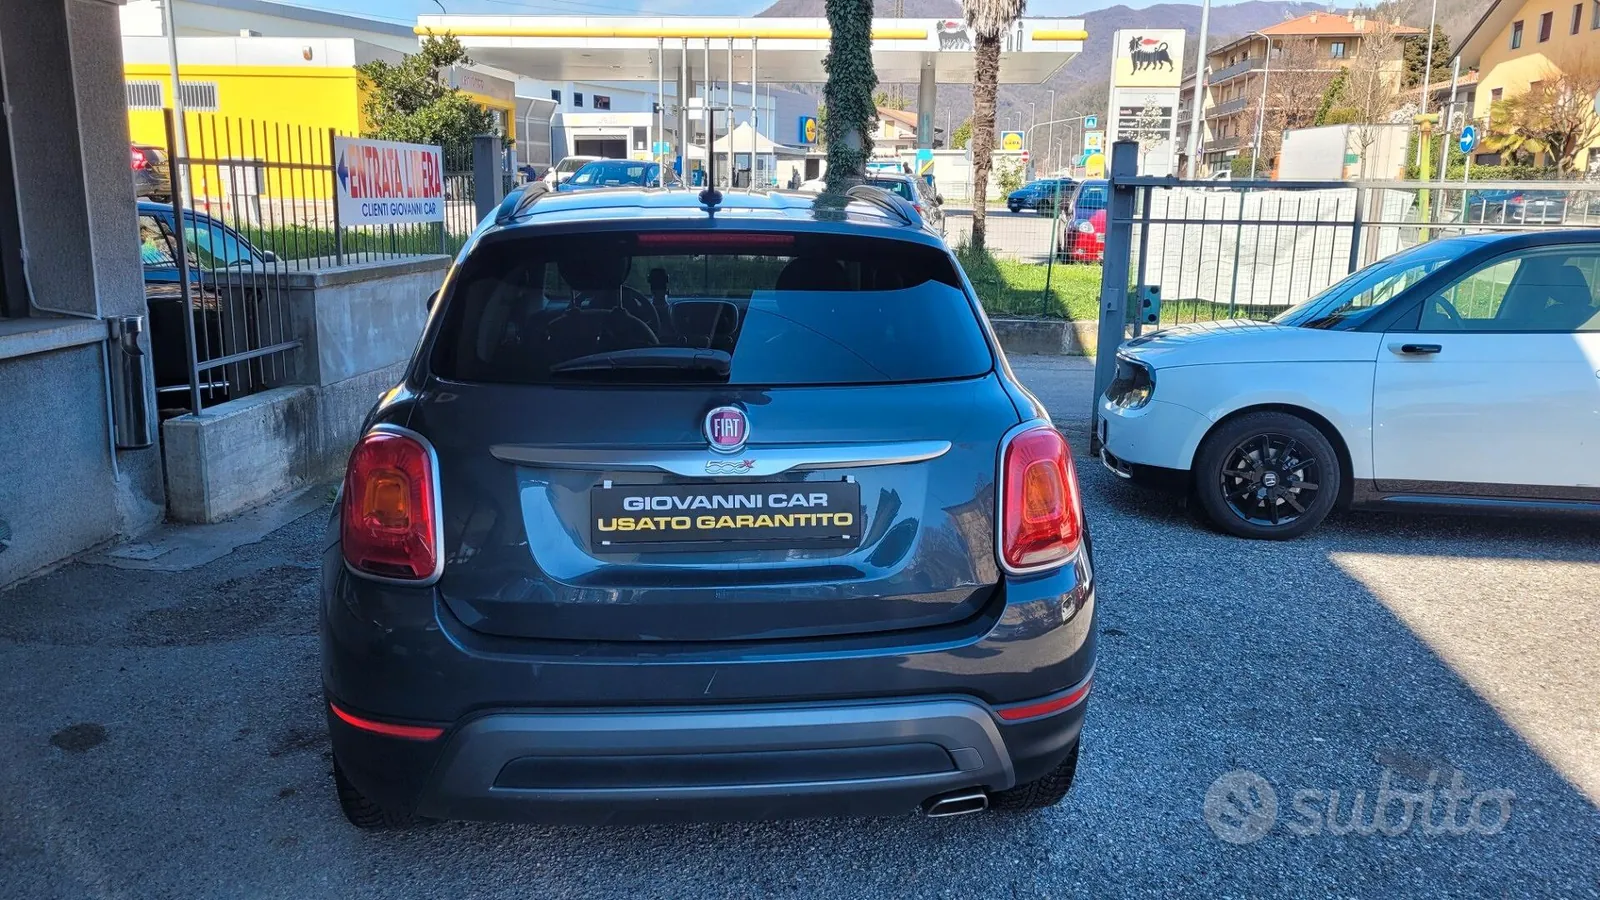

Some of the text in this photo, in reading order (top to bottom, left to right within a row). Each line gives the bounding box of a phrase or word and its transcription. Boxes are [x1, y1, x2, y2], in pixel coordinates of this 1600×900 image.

[347, 144, 404, 198] ENTRATA
[361, 202, 437, 217] CLIENTI GIOVANNI CAR
[714, 418, 740, 437] FIAT
[623, 492, 828, 511] GIOVANNI CAR
[598, 512, 853, 532] USATO GARANTITO
